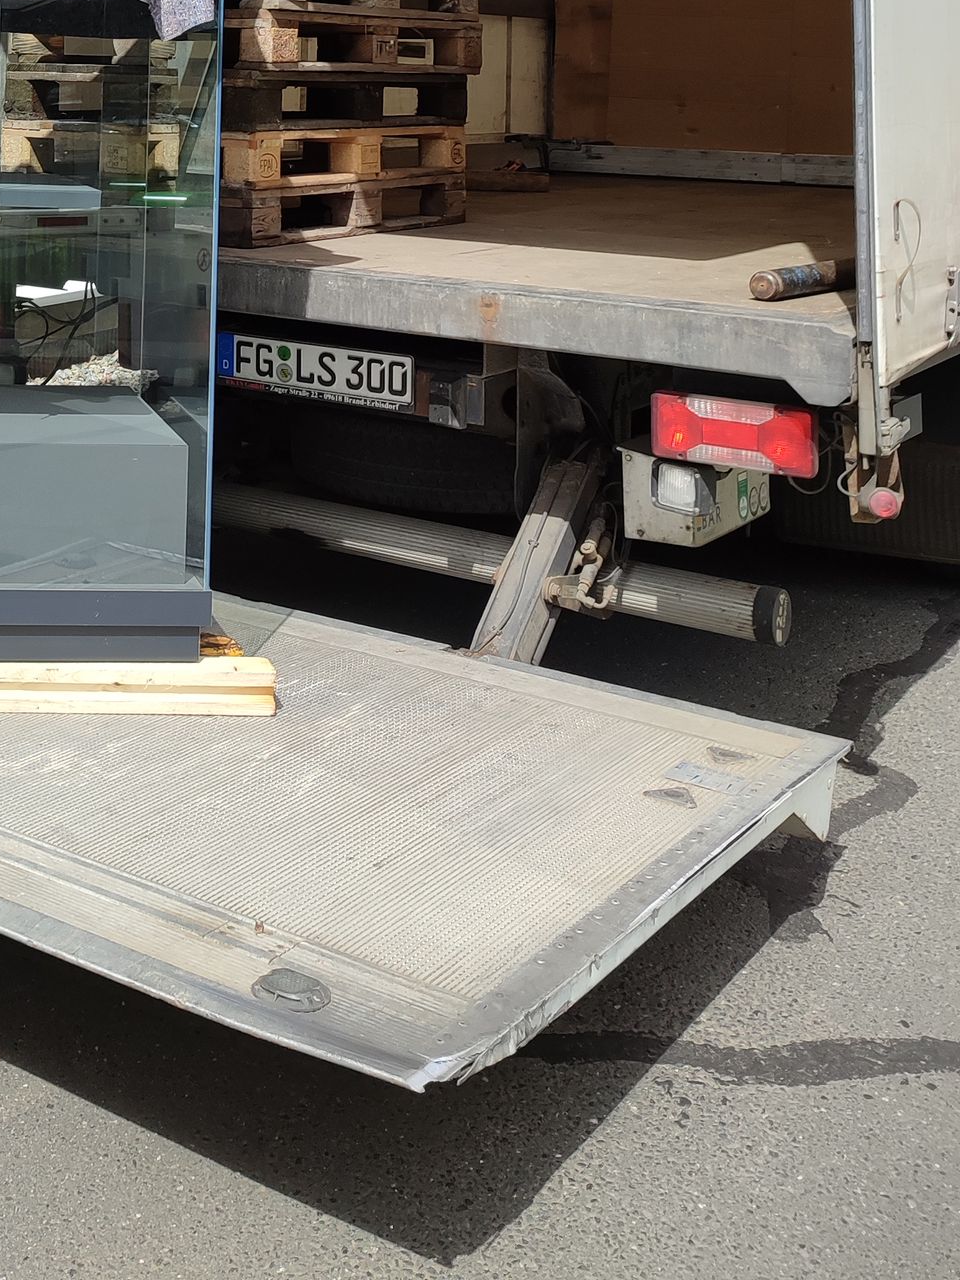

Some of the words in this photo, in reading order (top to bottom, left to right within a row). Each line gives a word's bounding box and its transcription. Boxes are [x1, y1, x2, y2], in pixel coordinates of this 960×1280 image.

[222, 359, 230, 370] D
[236, 340, 274, 378] FG
[296, 348, 337, 387] LS
[345, 354, 407, 397] 300
